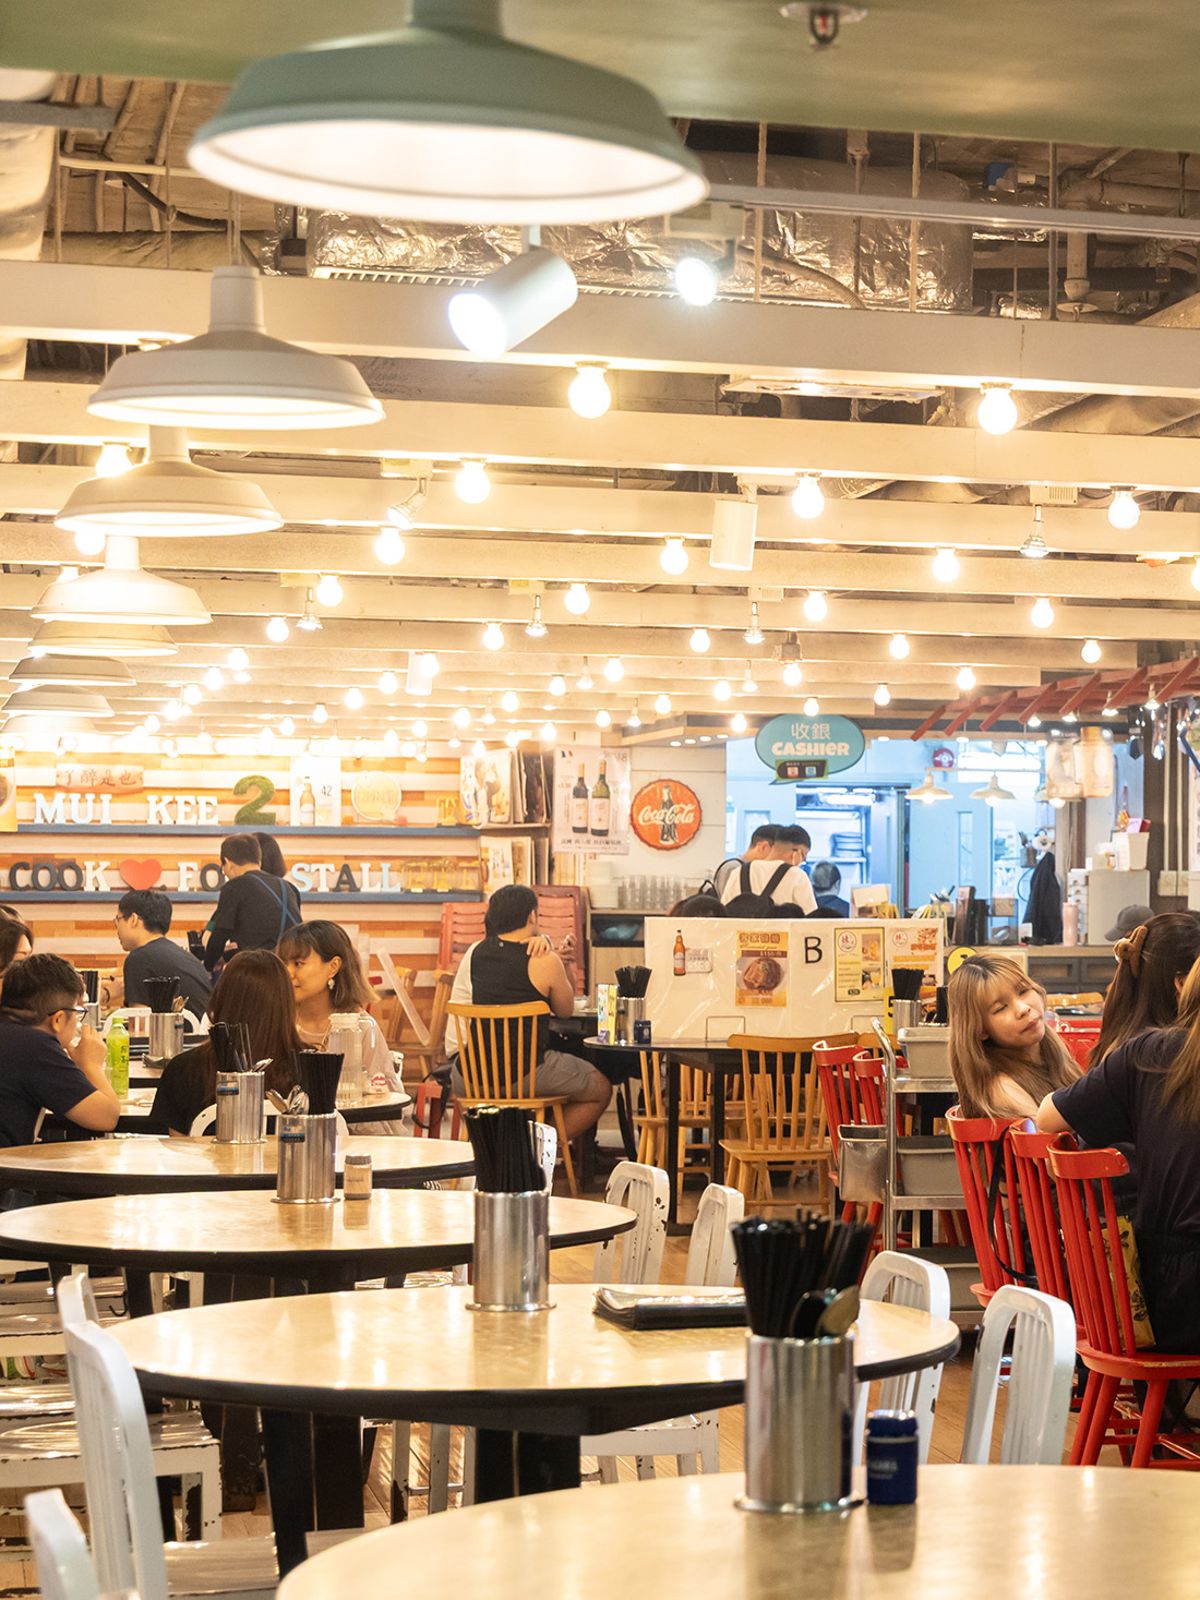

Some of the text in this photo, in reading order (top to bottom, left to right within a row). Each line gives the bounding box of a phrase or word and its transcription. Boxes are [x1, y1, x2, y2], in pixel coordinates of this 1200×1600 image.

[791, 722, 831, 740] 收銀
[771, 742, 850, 756] CASHIER
[34, 774, 277, 825] MUI KEE 2
[638, 802, 696, 826] Coca-Cola
[8, 861, 400, 893] COOK FO STALL
[804, 936, 823, 964] B
